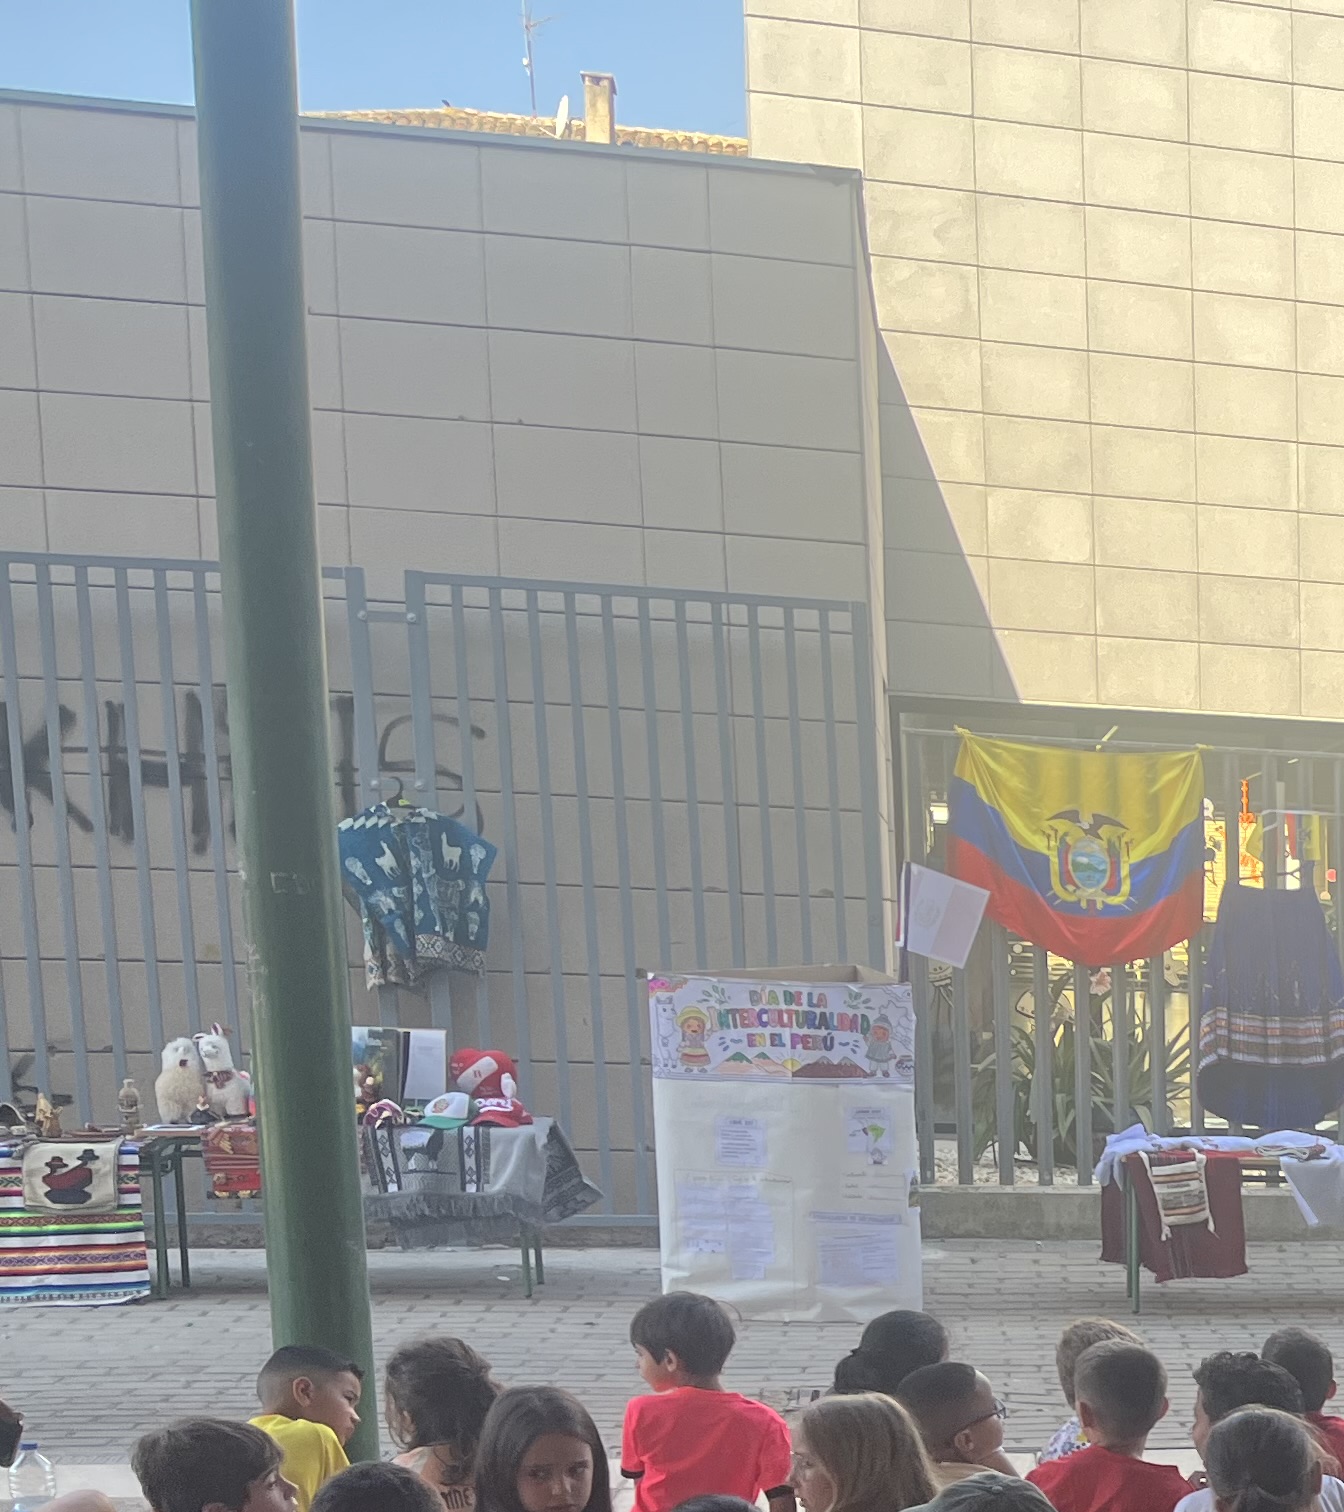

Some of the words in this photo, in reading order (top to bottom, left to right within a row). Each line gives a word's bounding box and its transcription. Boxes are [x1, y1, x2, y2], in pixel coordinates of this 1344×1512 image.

[750, 985, 780, 1007] DÍA
[784, 990, 804, 1007] DE
[807, 991, 828, 1009] LA
[706, 1006, 871, 1036] INTERCULTURALIDAD
[746, 1033, 767, 1048] EN
[769, 1033, 786, 1047] EL
[790, 1032, 835, 1052] PERÚ
